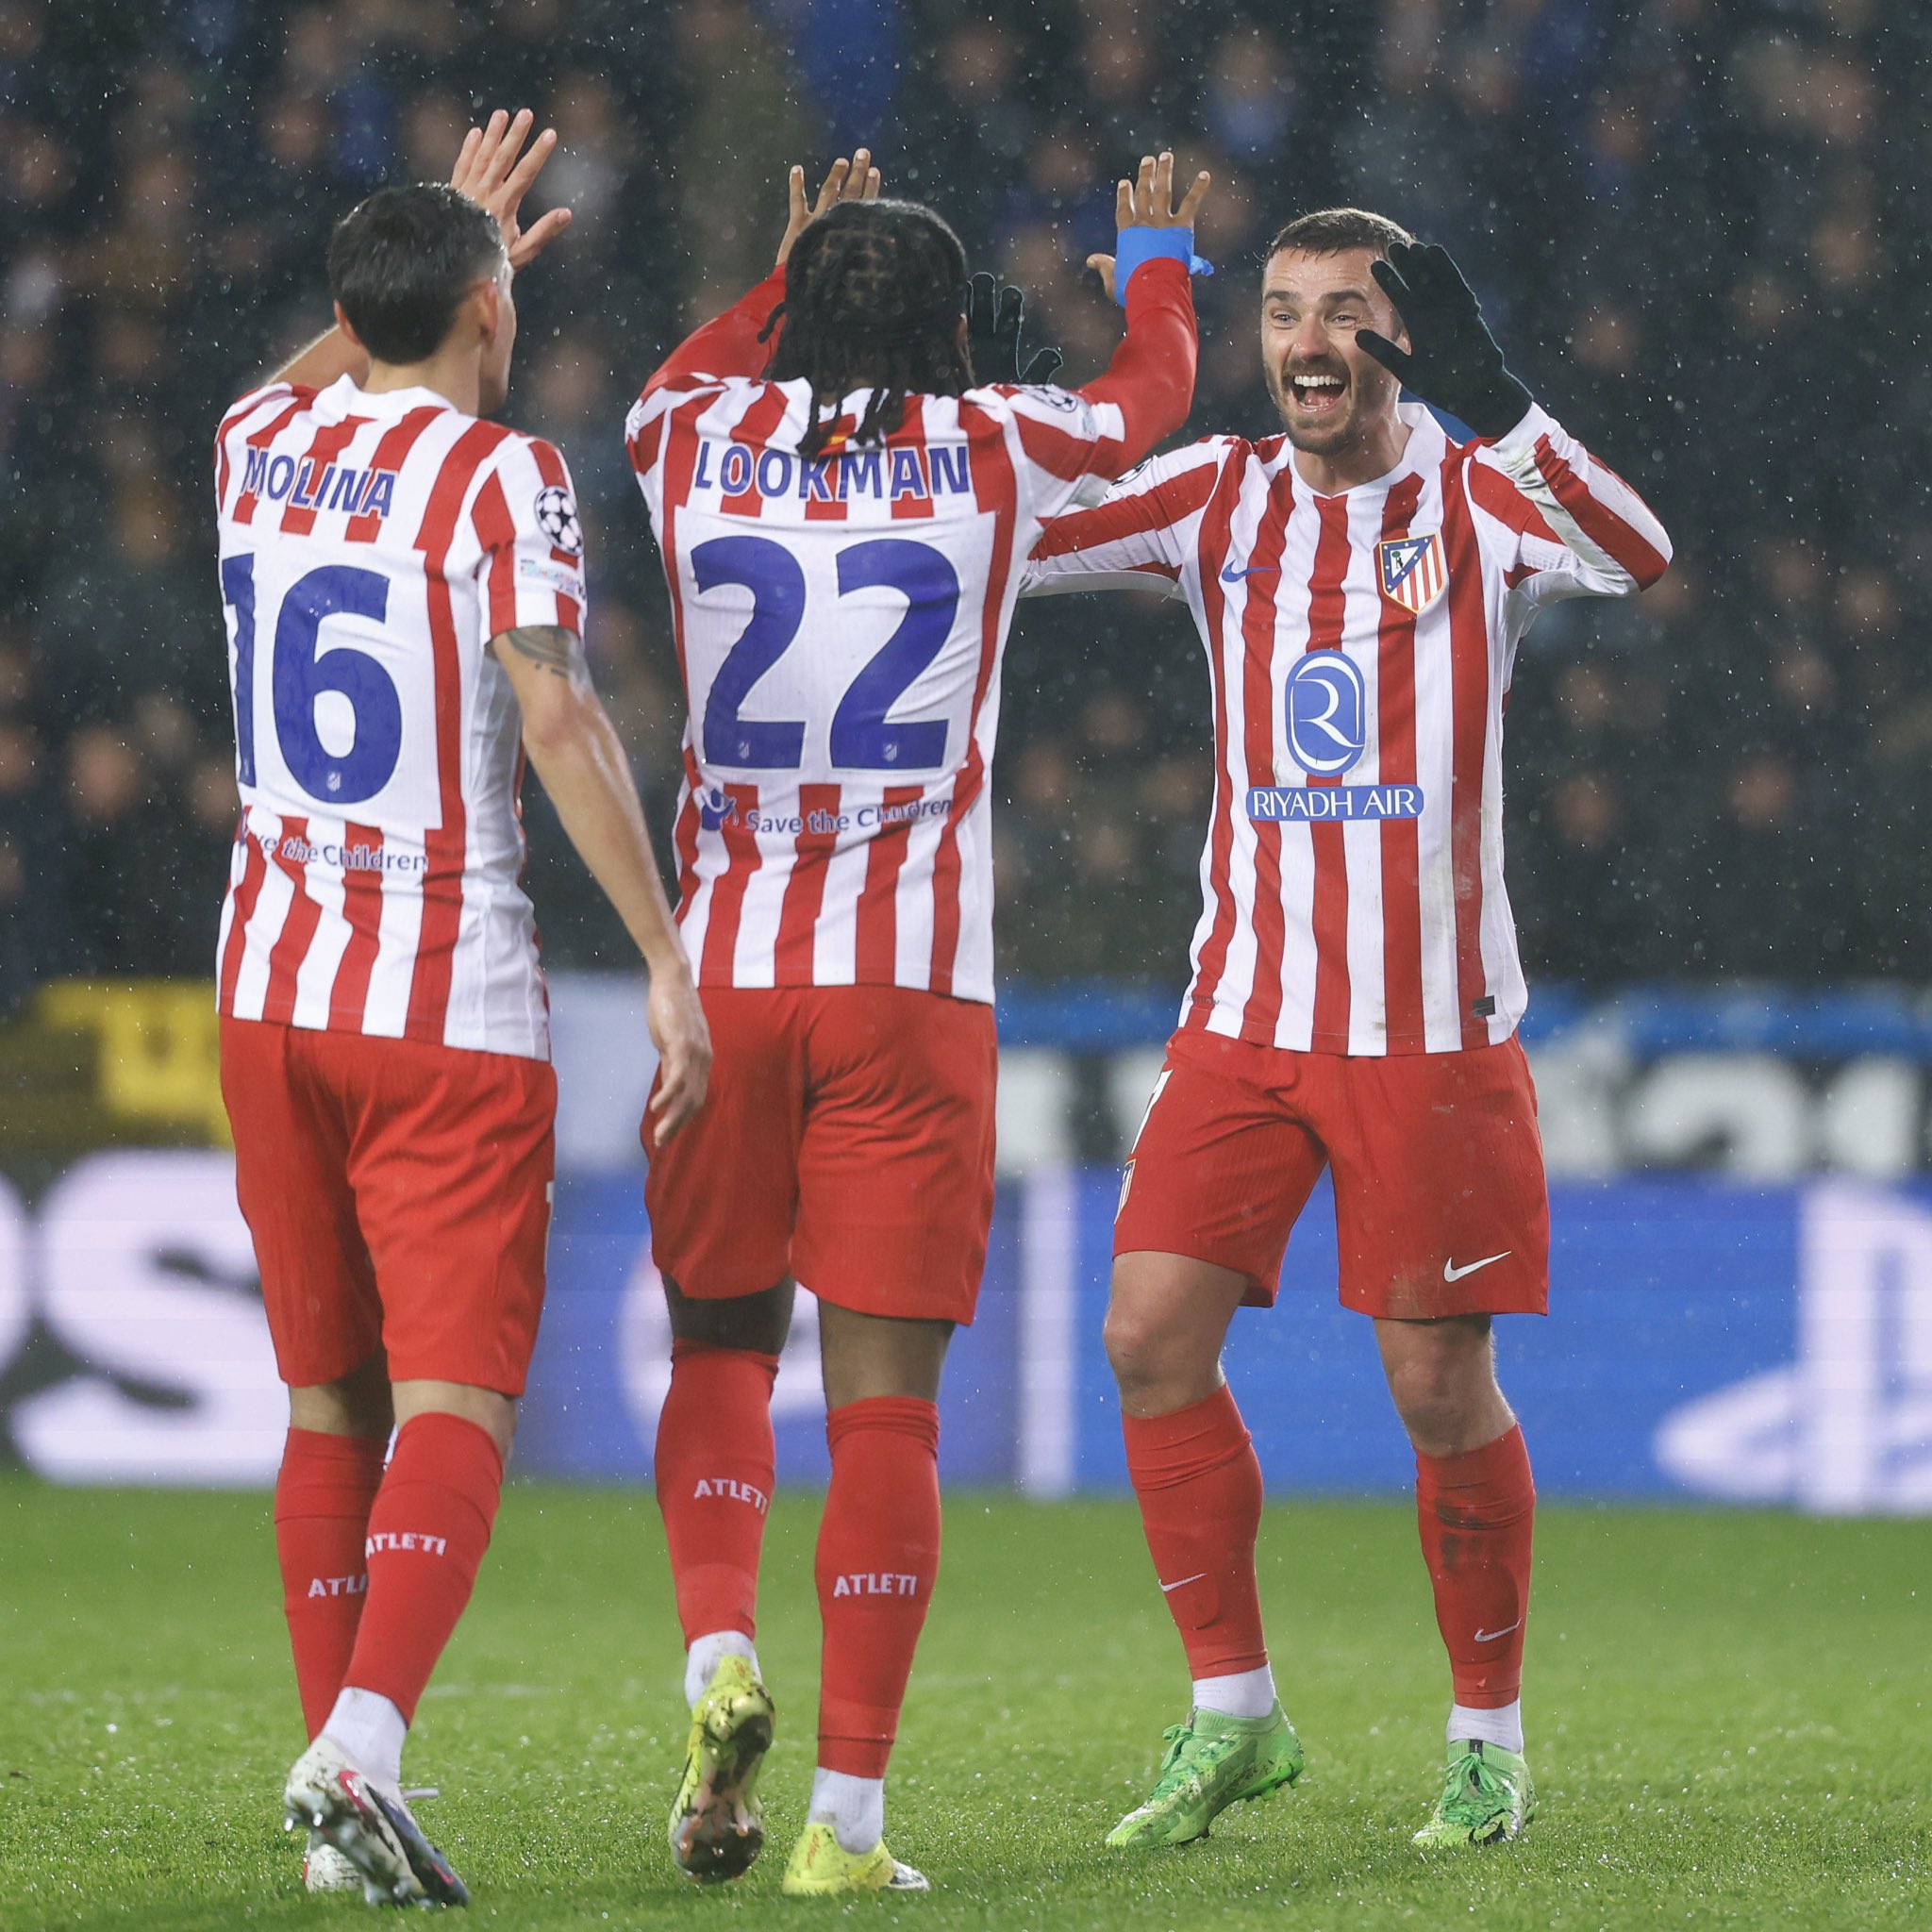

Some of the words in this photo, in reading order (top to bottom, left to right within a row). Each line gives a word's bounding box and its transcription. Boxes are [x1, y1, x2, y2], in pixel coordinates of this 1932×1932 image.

[241, 447, 395, 518] MOLINA
[693, 441, 970, 500] LOOKMAN
[690, 534, 960, 771] 22
[221, 552, 403, 805] 16
[1253, 790, 1353, 817] RIYADH
[1363, 789, 1417, 815] AIR
[746, 811, 801, 833] Save
[808, 810, 849, 833] the
[283, 838, 318, 862] the
[323, 844, 429, 871] Children
[694, 1478, 769, 1516] ATLETI
[364, 1531, 447, 1560] ATLETI
[834, 1573, 918, 1598] ATLETI
